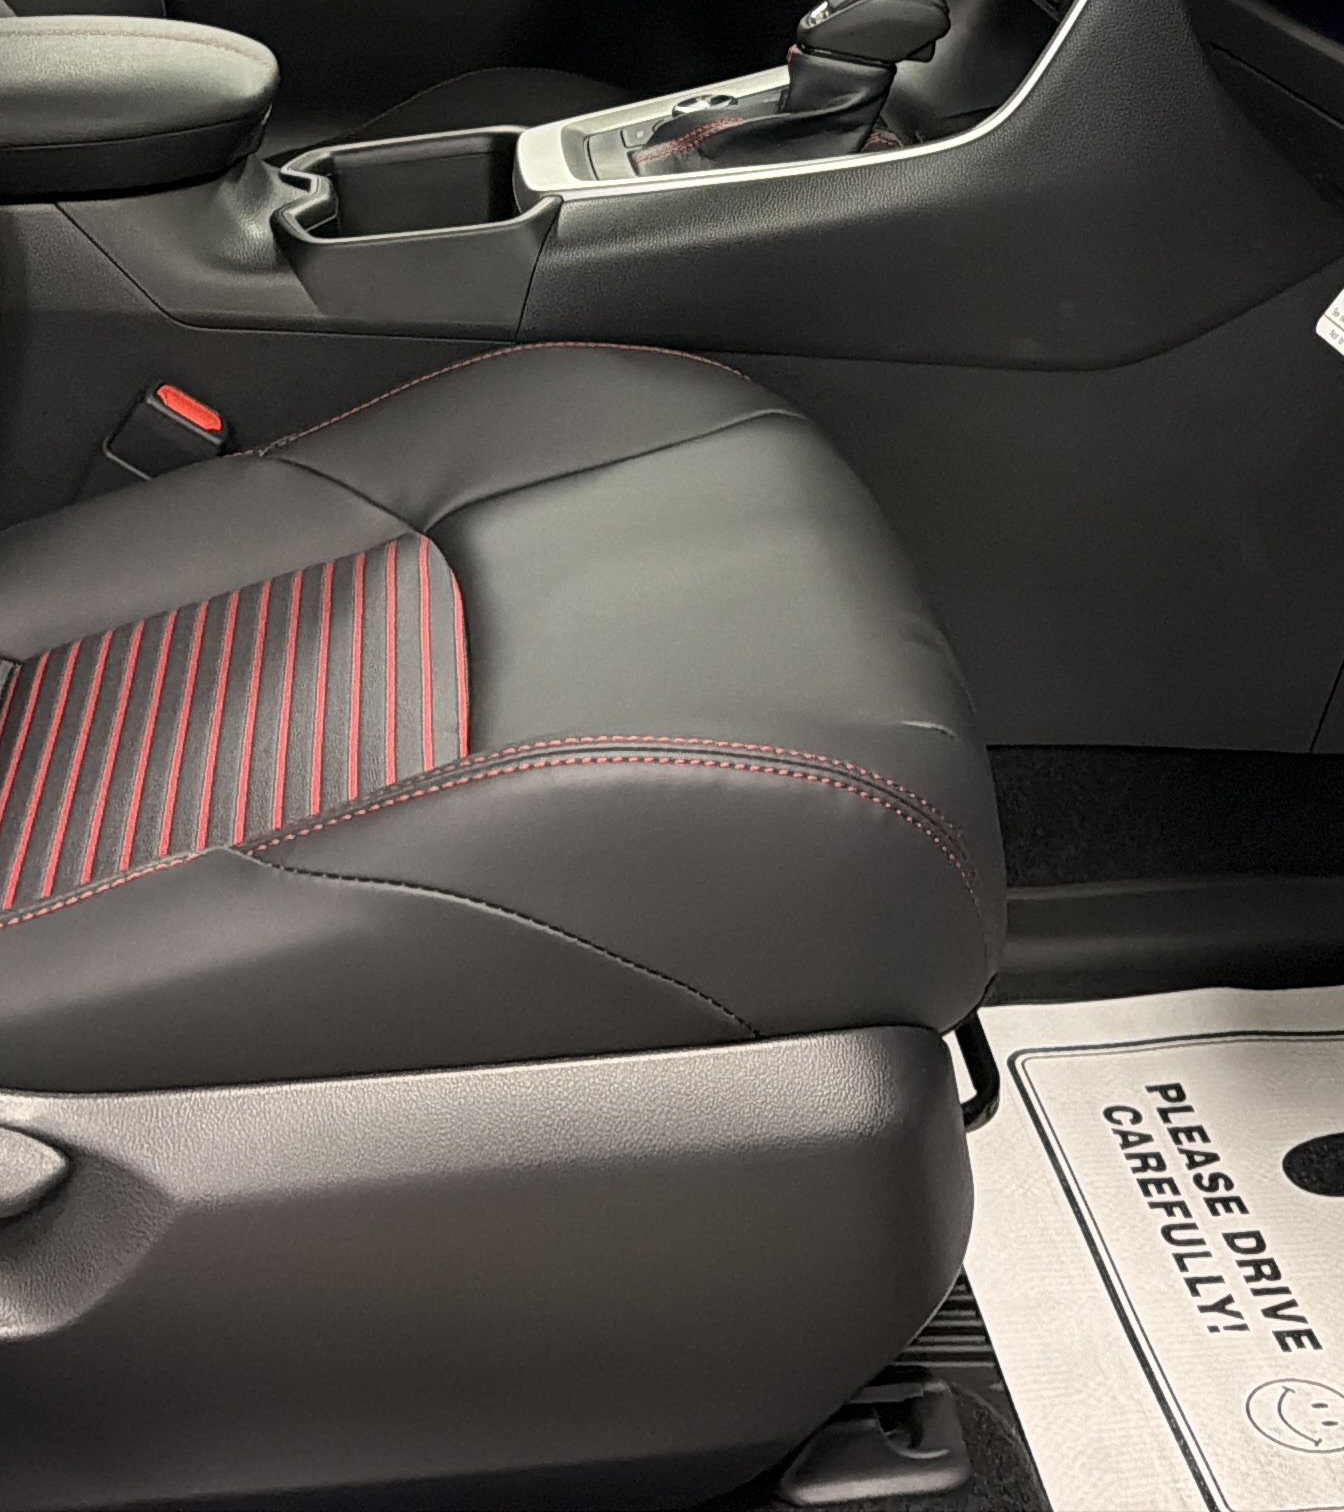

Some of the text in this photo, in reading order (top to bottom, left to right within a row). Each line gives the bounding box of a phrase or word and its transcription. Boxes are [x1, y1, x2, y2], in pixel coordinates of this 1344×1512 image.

[1103, 1105, 1250, 1333] CAREFULLY!
[1145, 1082, 1323, 1352] PLEASE DRIVE
